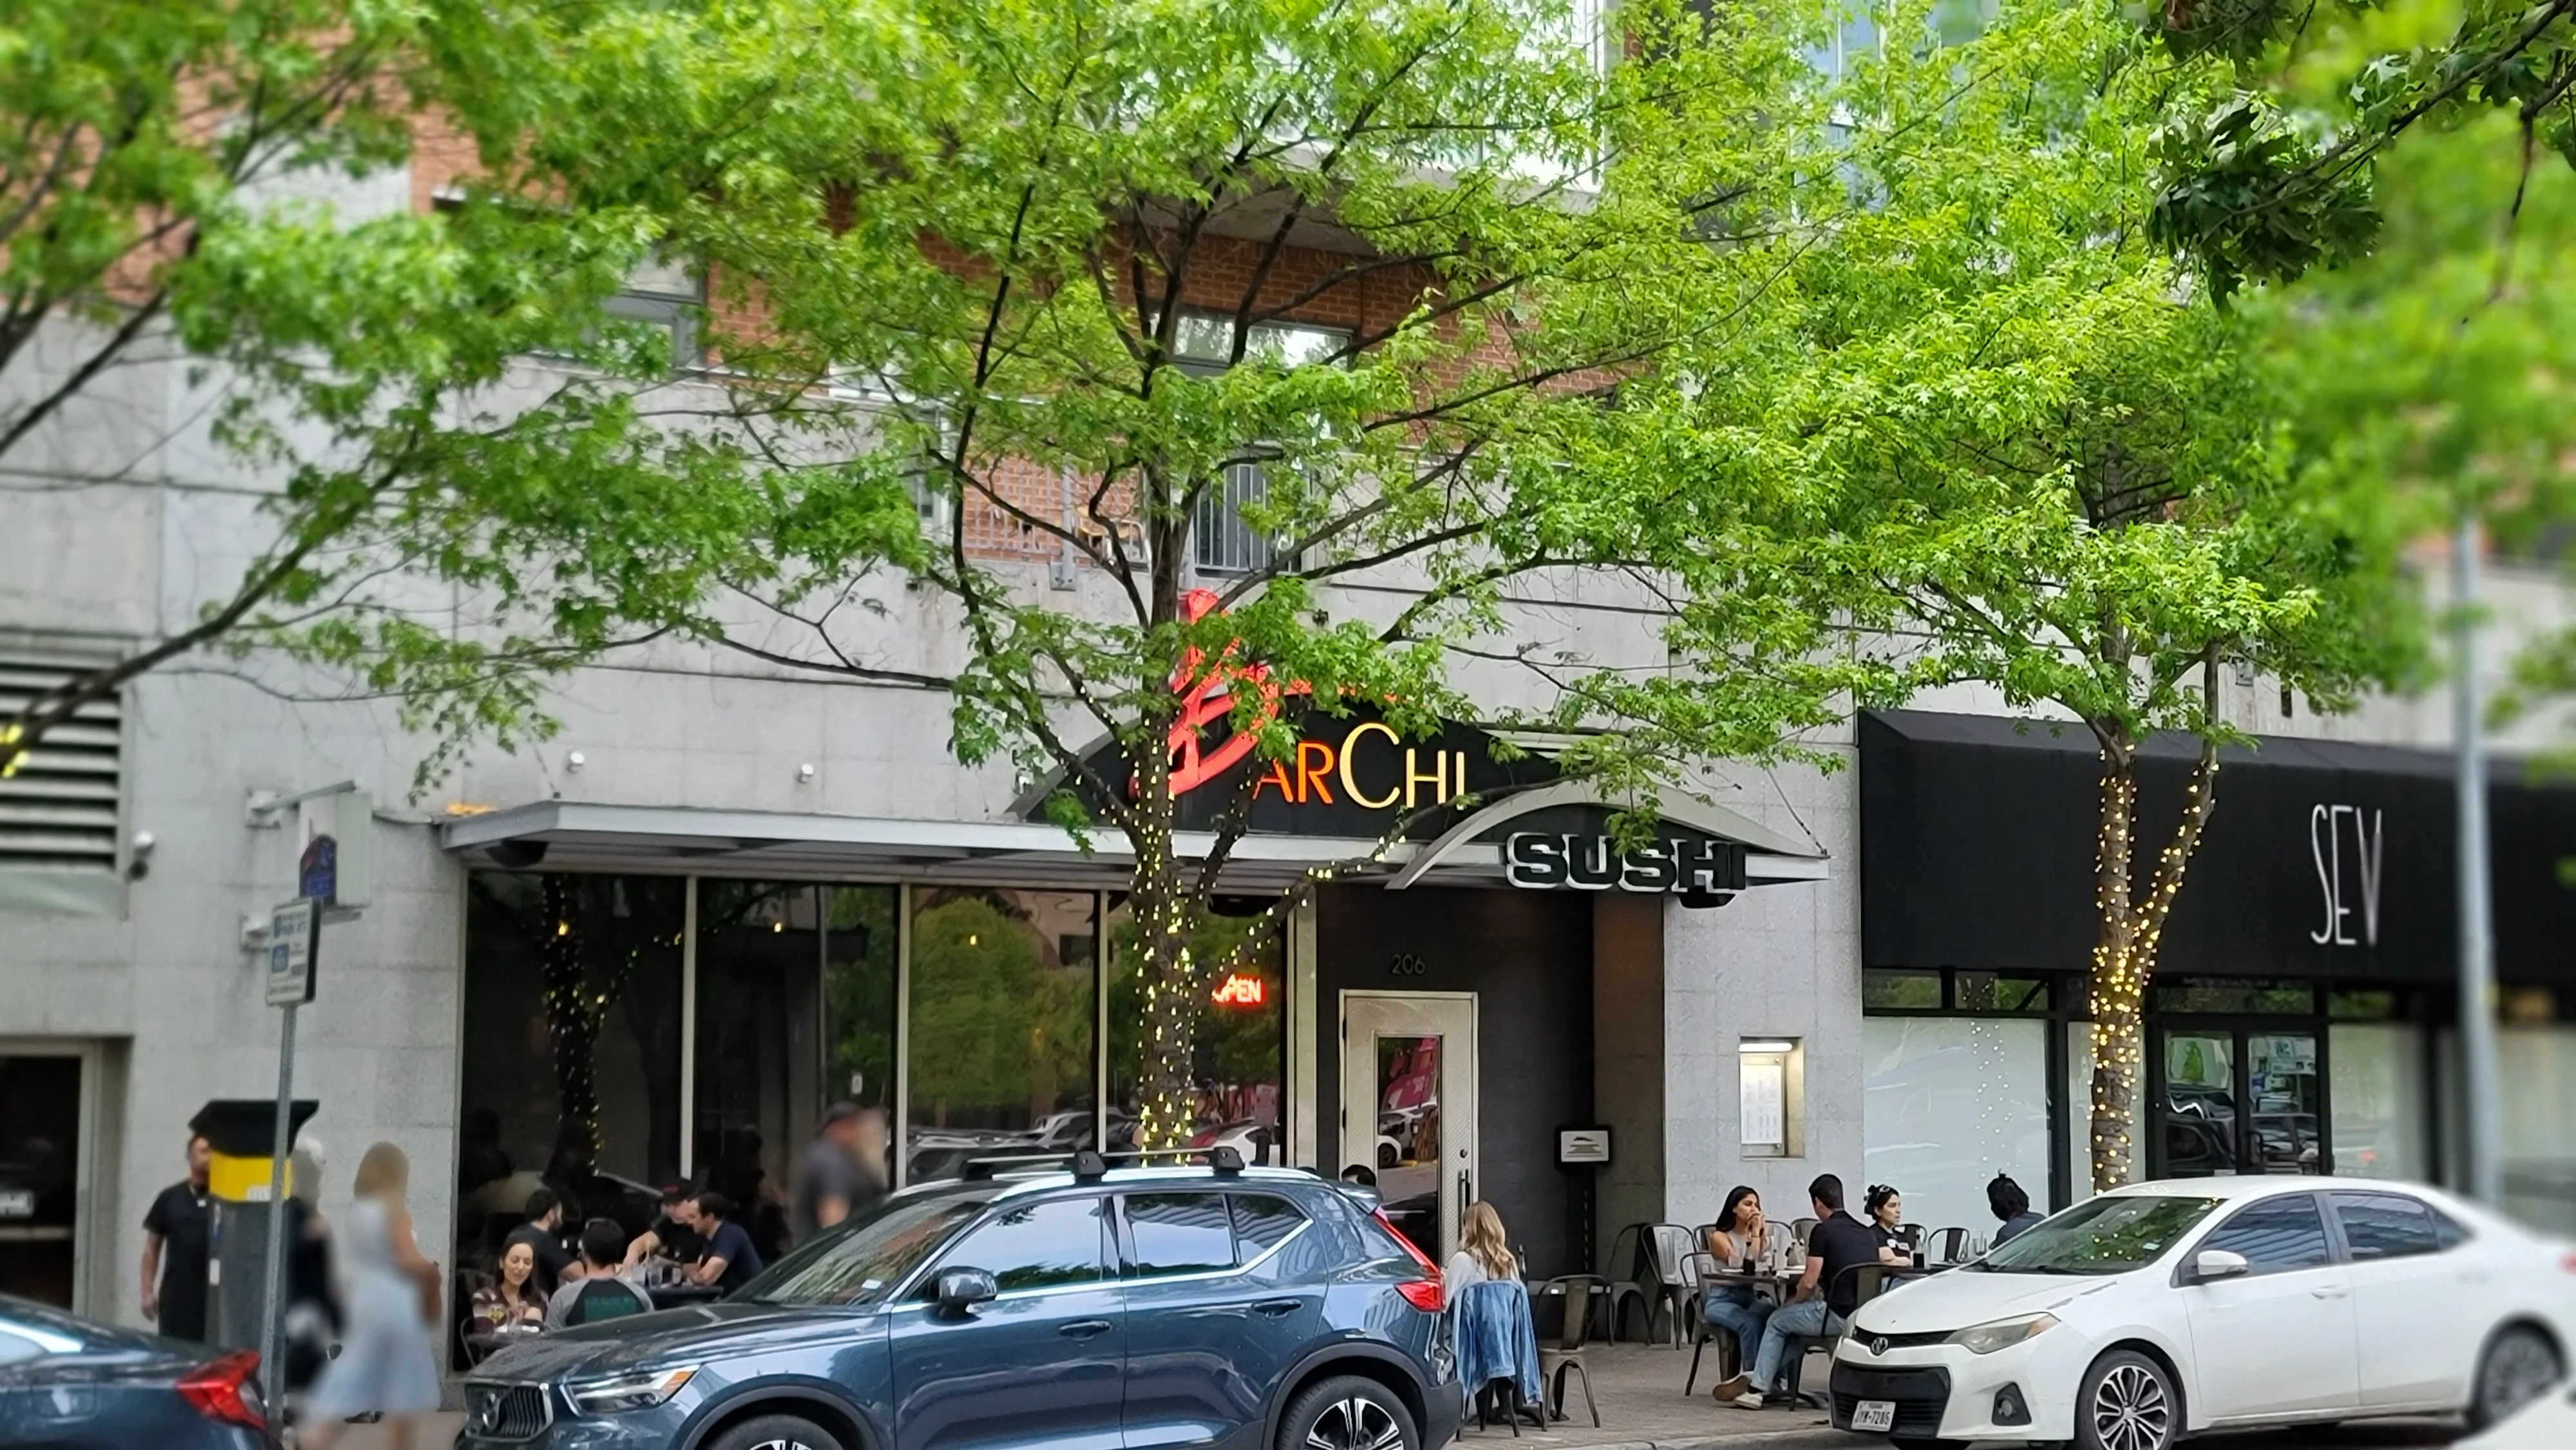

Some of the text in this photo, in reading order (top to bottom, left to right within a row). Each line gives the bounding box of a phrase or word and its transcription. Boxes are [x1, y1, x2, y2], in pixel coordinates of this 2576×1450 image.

[1506, 832, 1747, 894] SUSHI
[2311, 804, 2382, 945] SEV
[1391, 954, 1426, 975] 206
